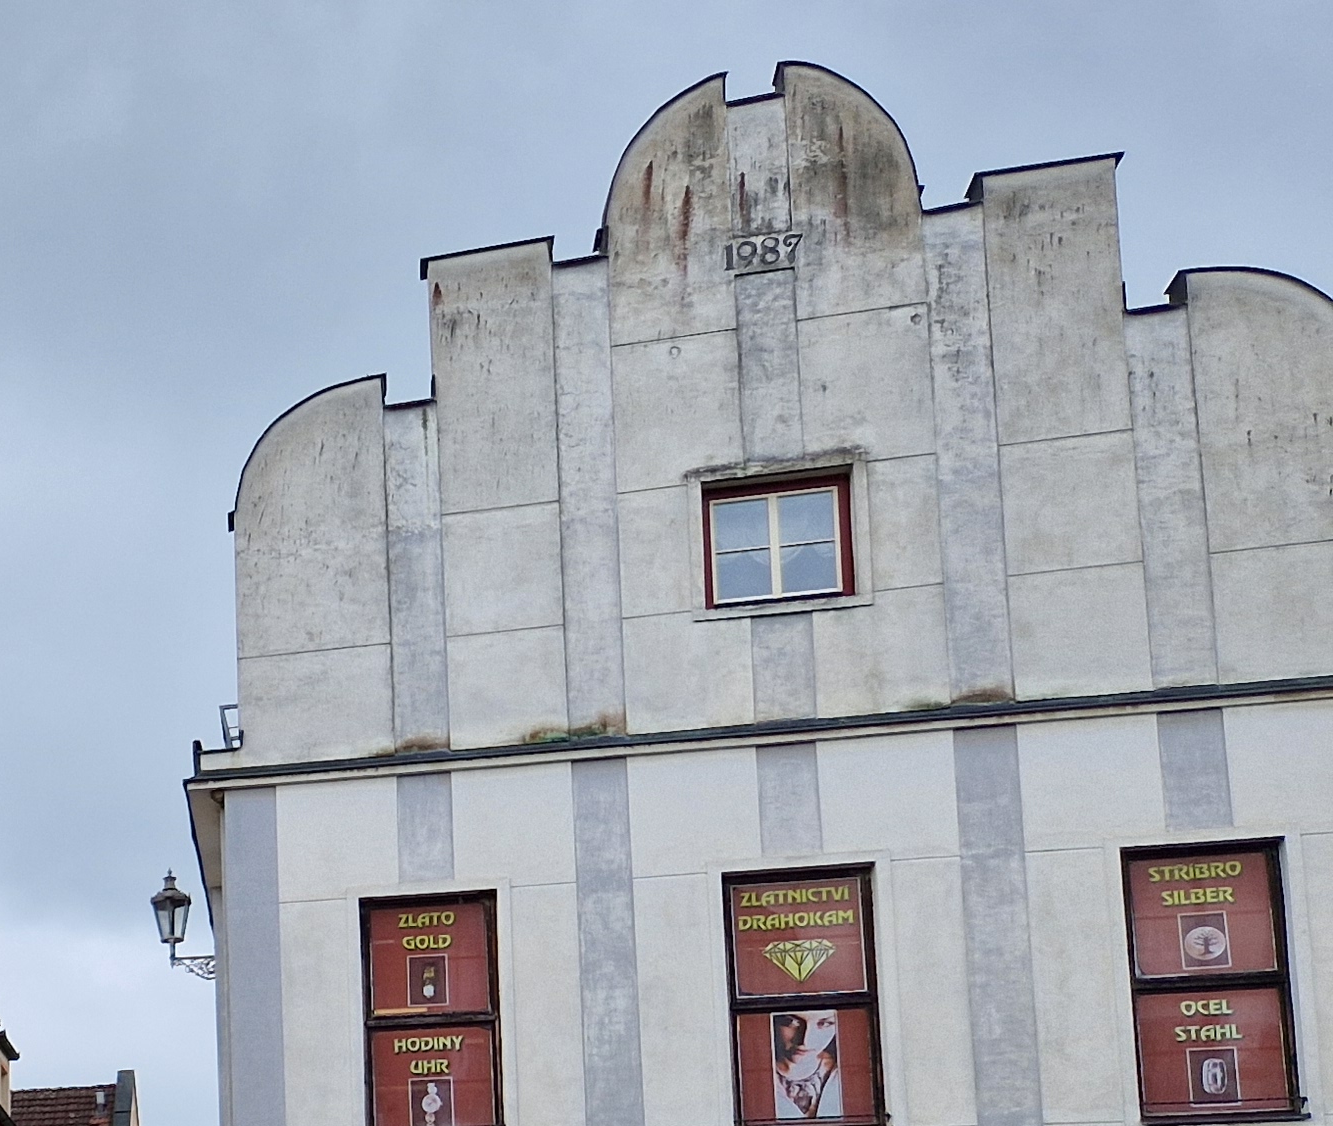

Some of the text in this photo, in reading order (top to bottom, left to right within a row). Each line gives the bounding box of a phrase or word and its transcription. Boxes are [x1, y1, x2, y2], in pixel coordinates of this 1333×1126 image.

[724, 232, 803, 271] 1987
[1161, 886, 1235, 906] SILBER
[398, 911, 455, 928] ZLATO
[738, 909, 854, 931] DRAHOKAM
[402, 934, 452, 950] GOLD
[1180, 1000, 1233, 1016] OCEL
[1174, 1025, 1242, 1042] STAHL
[394, 1035, 464, 1053] HODINY
[410, 1058, 449, 1075] UHR
